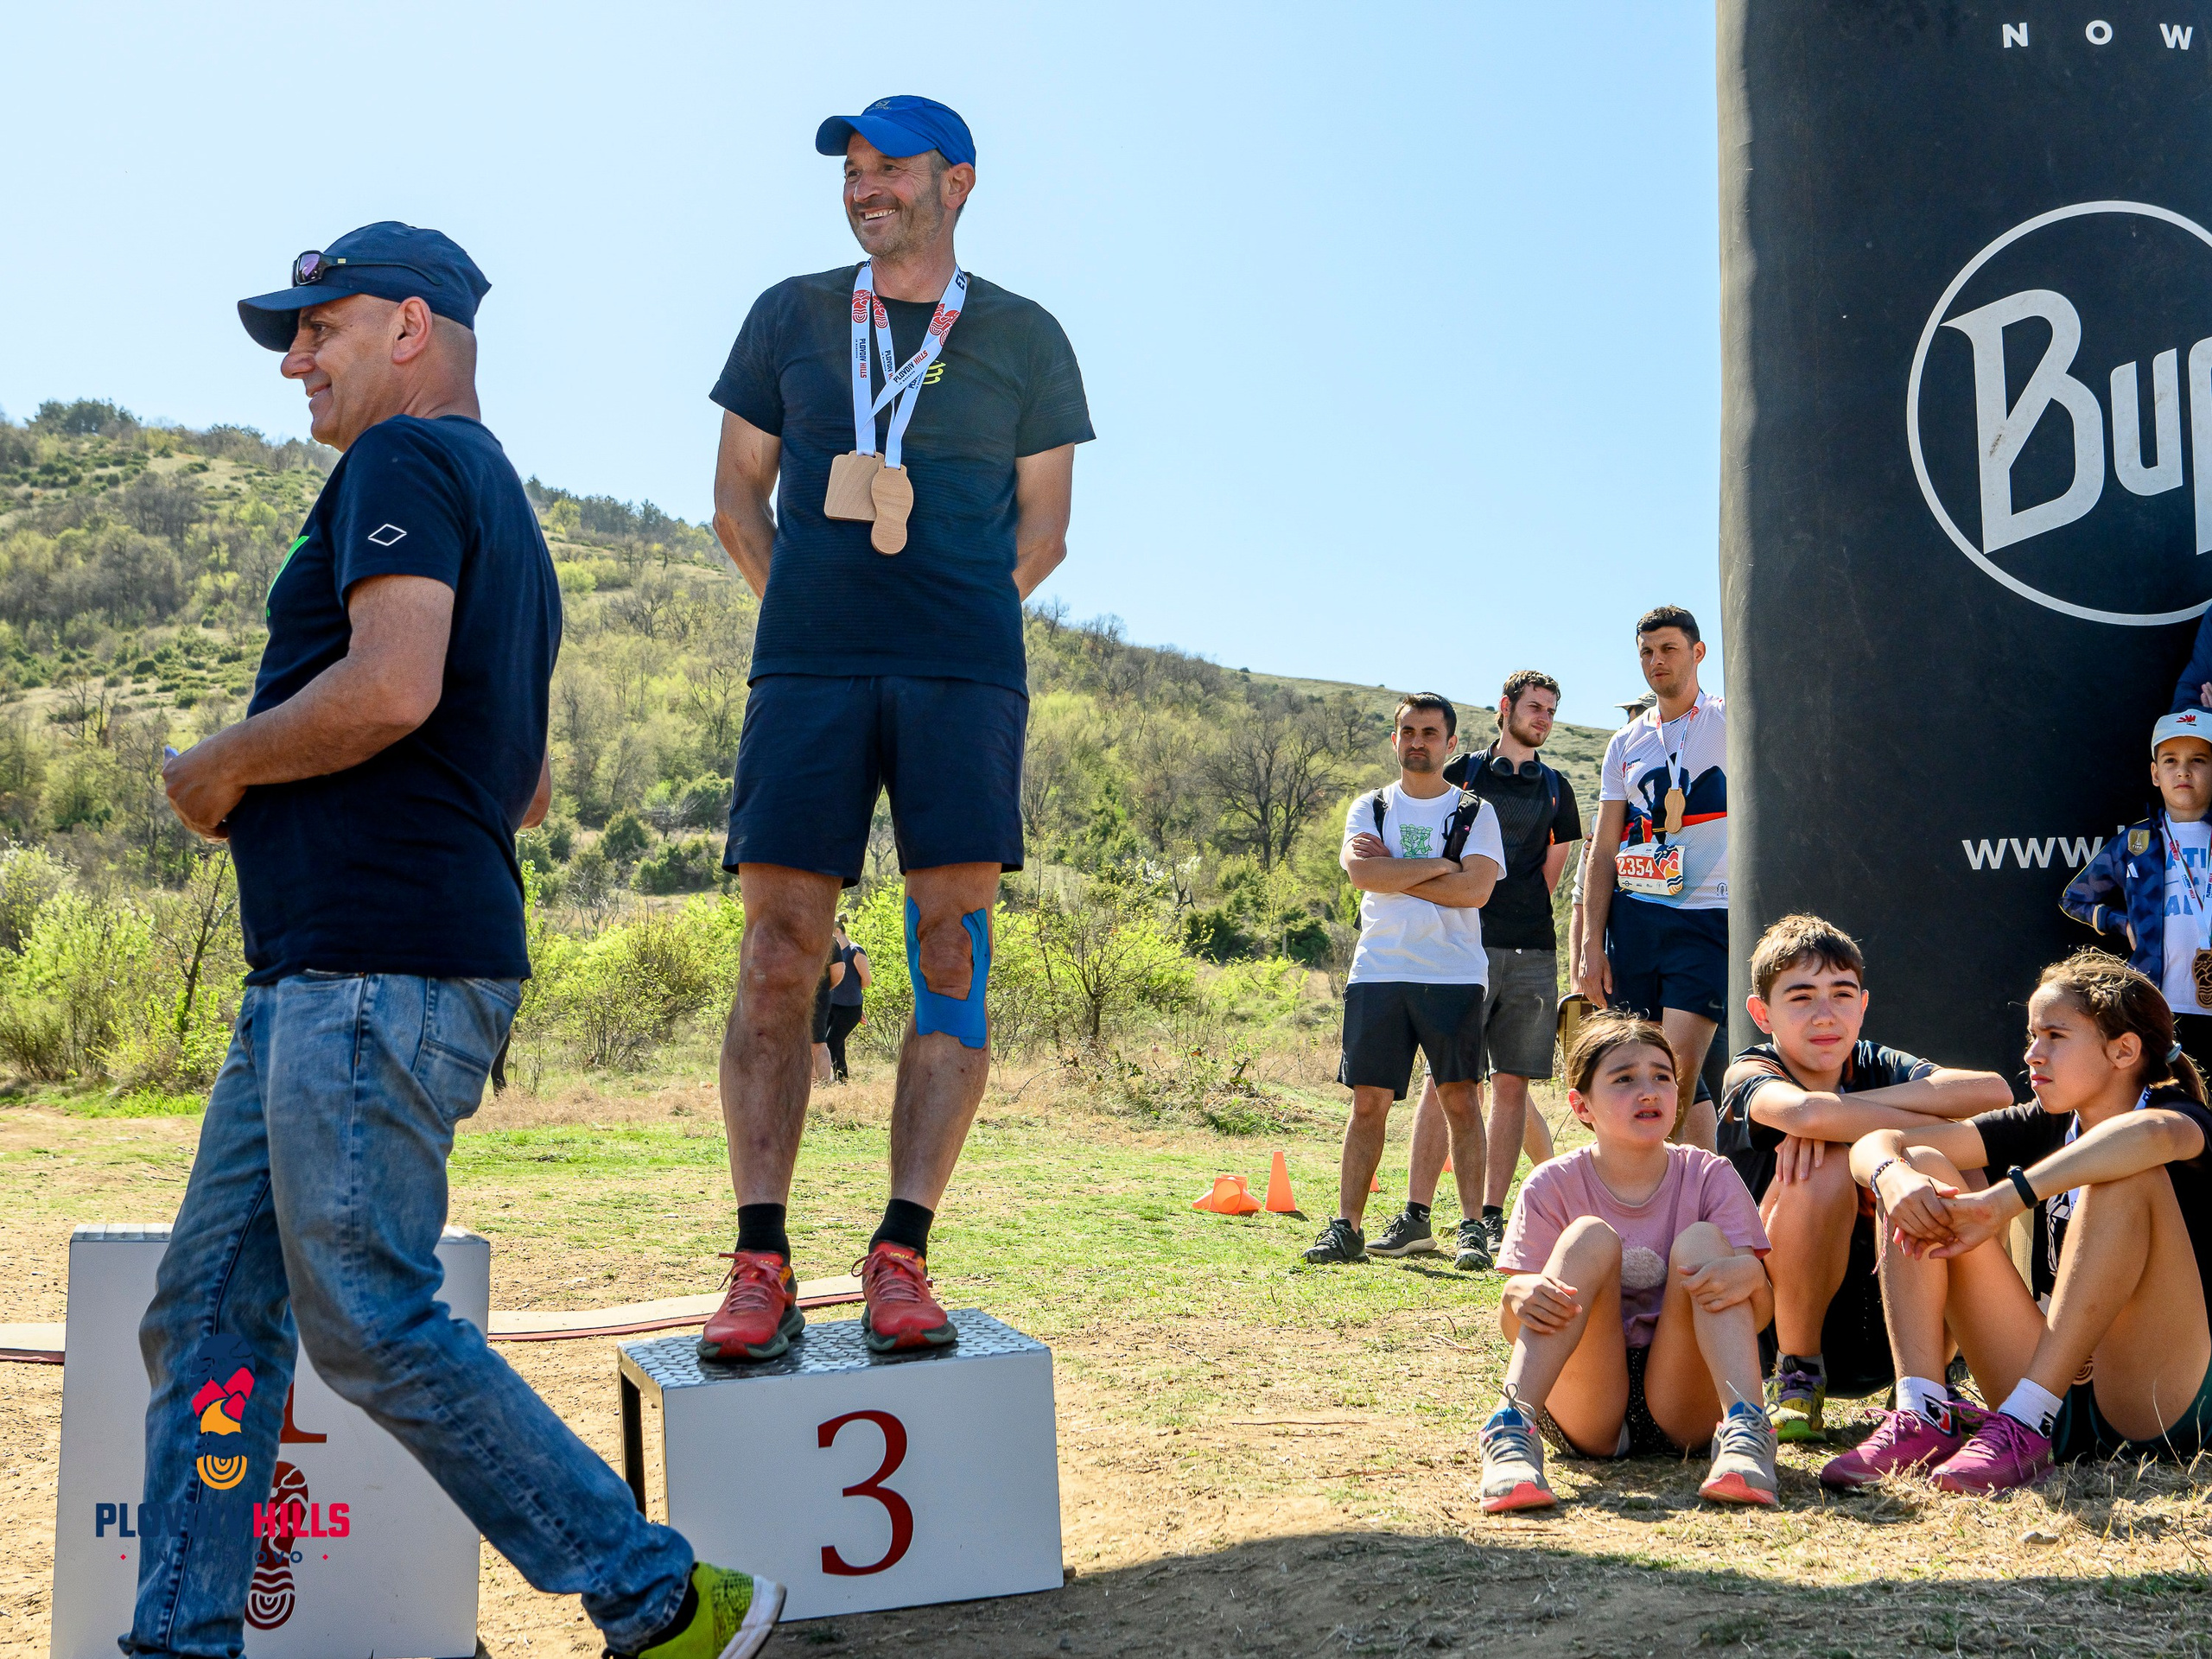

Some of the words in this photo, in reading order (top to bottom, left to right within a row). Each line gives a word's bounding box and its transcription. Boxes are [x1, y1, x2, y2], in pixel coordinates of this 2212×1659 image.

[893, 361, 915, 383] PLOVDIV
[913, 350, 929, 365] HILLS
[1617, 857, 1655, 878] 2354
[817, 1409, 914, 1576] 3
